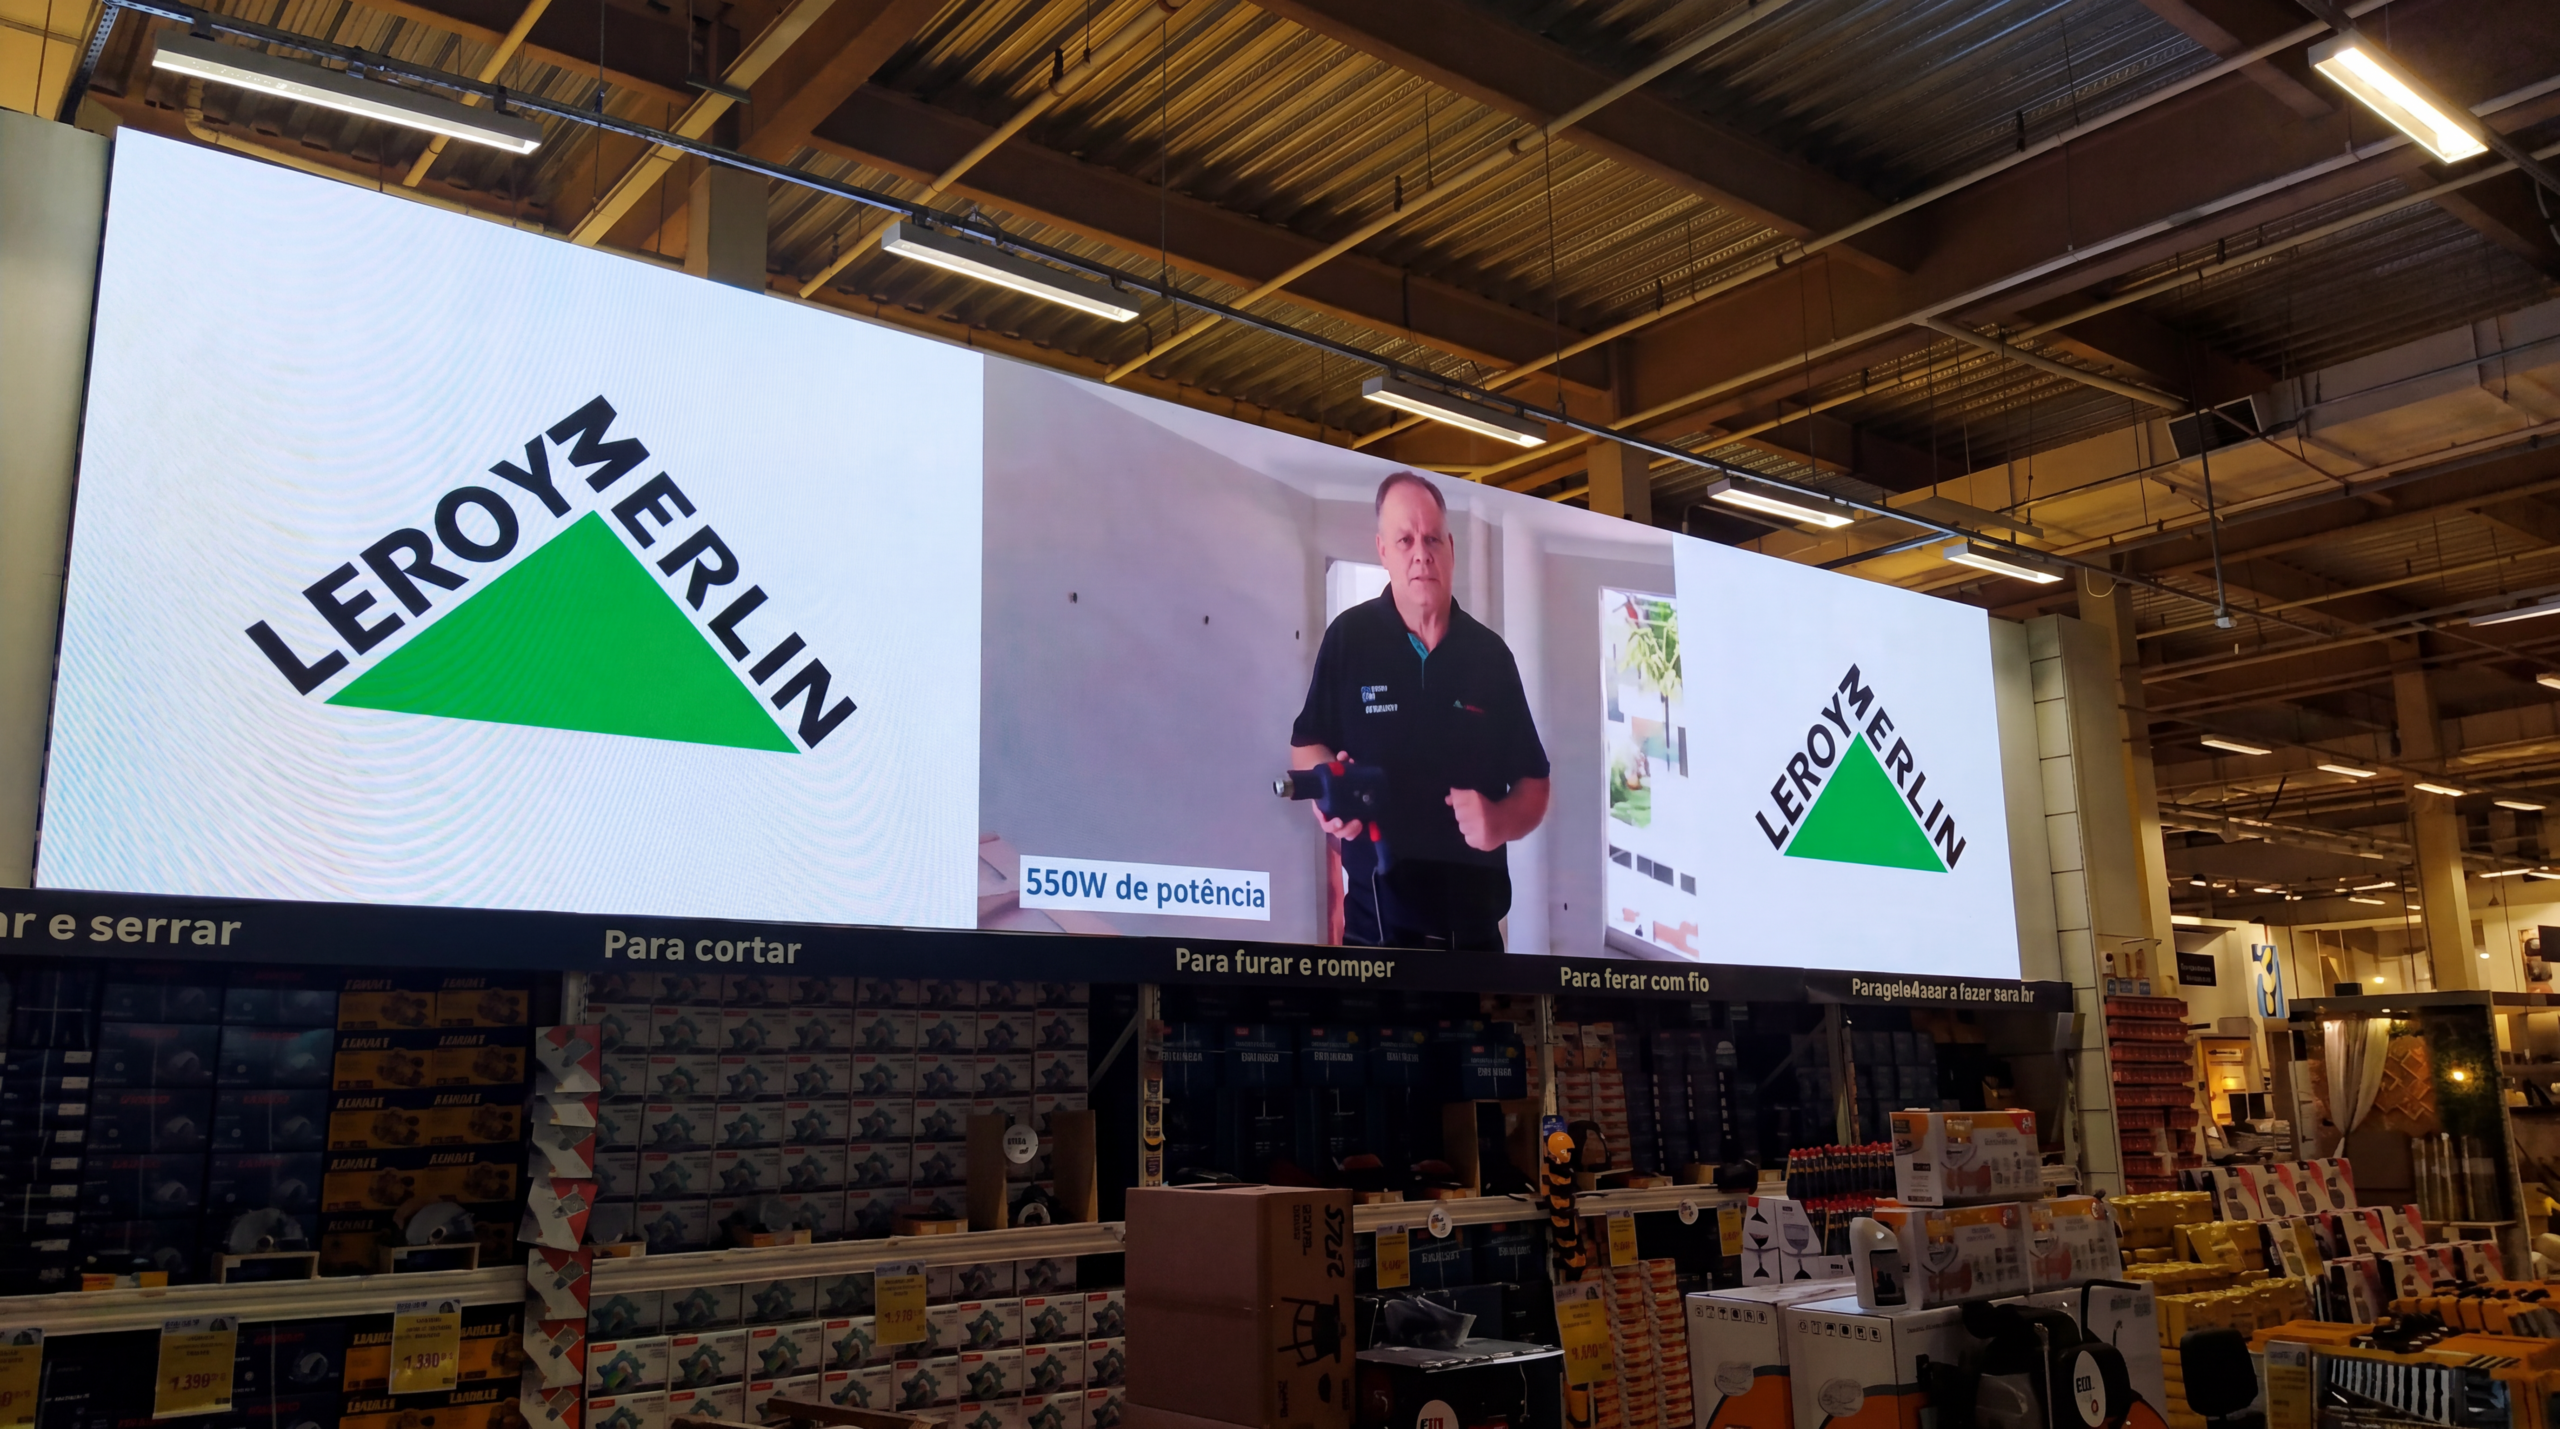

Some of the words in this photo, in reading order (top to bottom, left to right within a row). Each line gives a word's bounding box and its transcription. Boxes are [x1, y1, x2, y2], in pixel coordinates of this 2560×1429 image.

[245, 434, 572, 697] LEROY
[545, 394, 858, 750] MERLIN
[1755, 691, 1852, 851] LEROY
[1838, 662, 1967, 870] MERLIN
[1026, 867, 1108, 899] 550W
[1116, 873, 1148, 901] de
[1157, 877, 1266, 909] potência
[49, 914, 76, 940] e
[89, 915, 242, 946] serrar
[604, 929, 685, 961] Para
[695, 936, 803, 964] cortar
[1176, 947, 1229, 973] Para
[1235, 949, 1294, 975] furar
[1299, 957, 1312, 976] e
[1317, 957, 1395, 983] romper
[1560, 966, 1601, 988] Para
[1604, 967, 1648, 990] ferar
[1651, 975, 1685, 992] com
[1687, 971, 1710, 993] fio
[1959, 982, 1992, 1002] fazer
